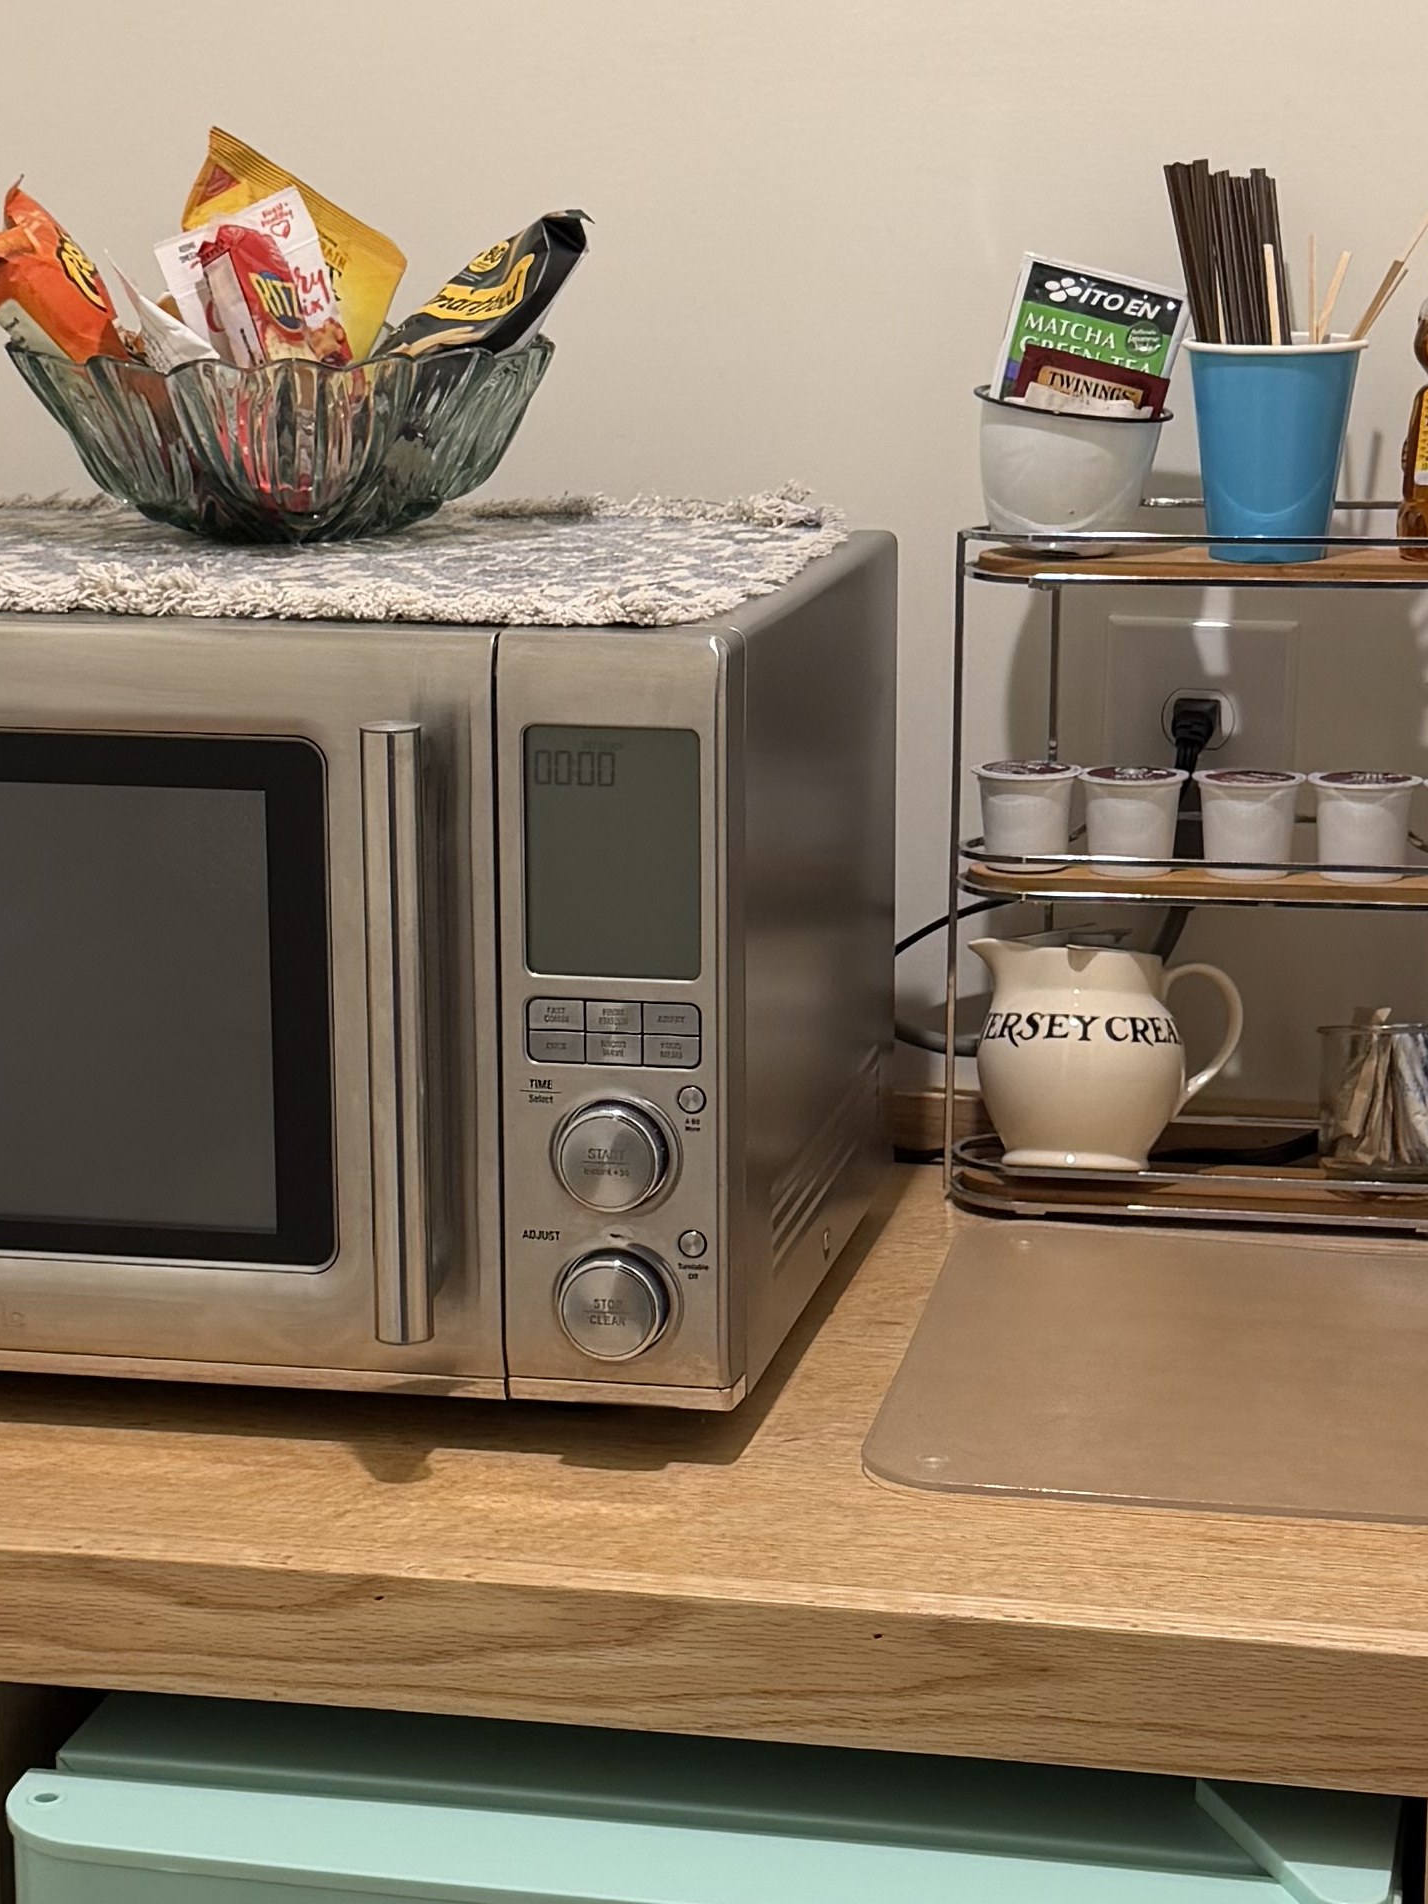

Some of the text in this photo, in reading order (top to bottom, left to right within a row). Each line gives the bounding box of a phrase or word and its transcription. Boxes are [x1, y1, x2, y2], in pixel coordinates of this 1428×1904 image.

[248, 272, 303, 318] RITZ
[1079, 287, 1160, 320] ITO EN
[1025, 312, 1116, 350] MATCHA
[983, 1011, 1182, 1047] ERSEY CREA
[529, 1079, 553, 1090] TIME
[522, 1230, 561, 1241] ADJUST
[589, 1315, 628, 1326] CLEAR
